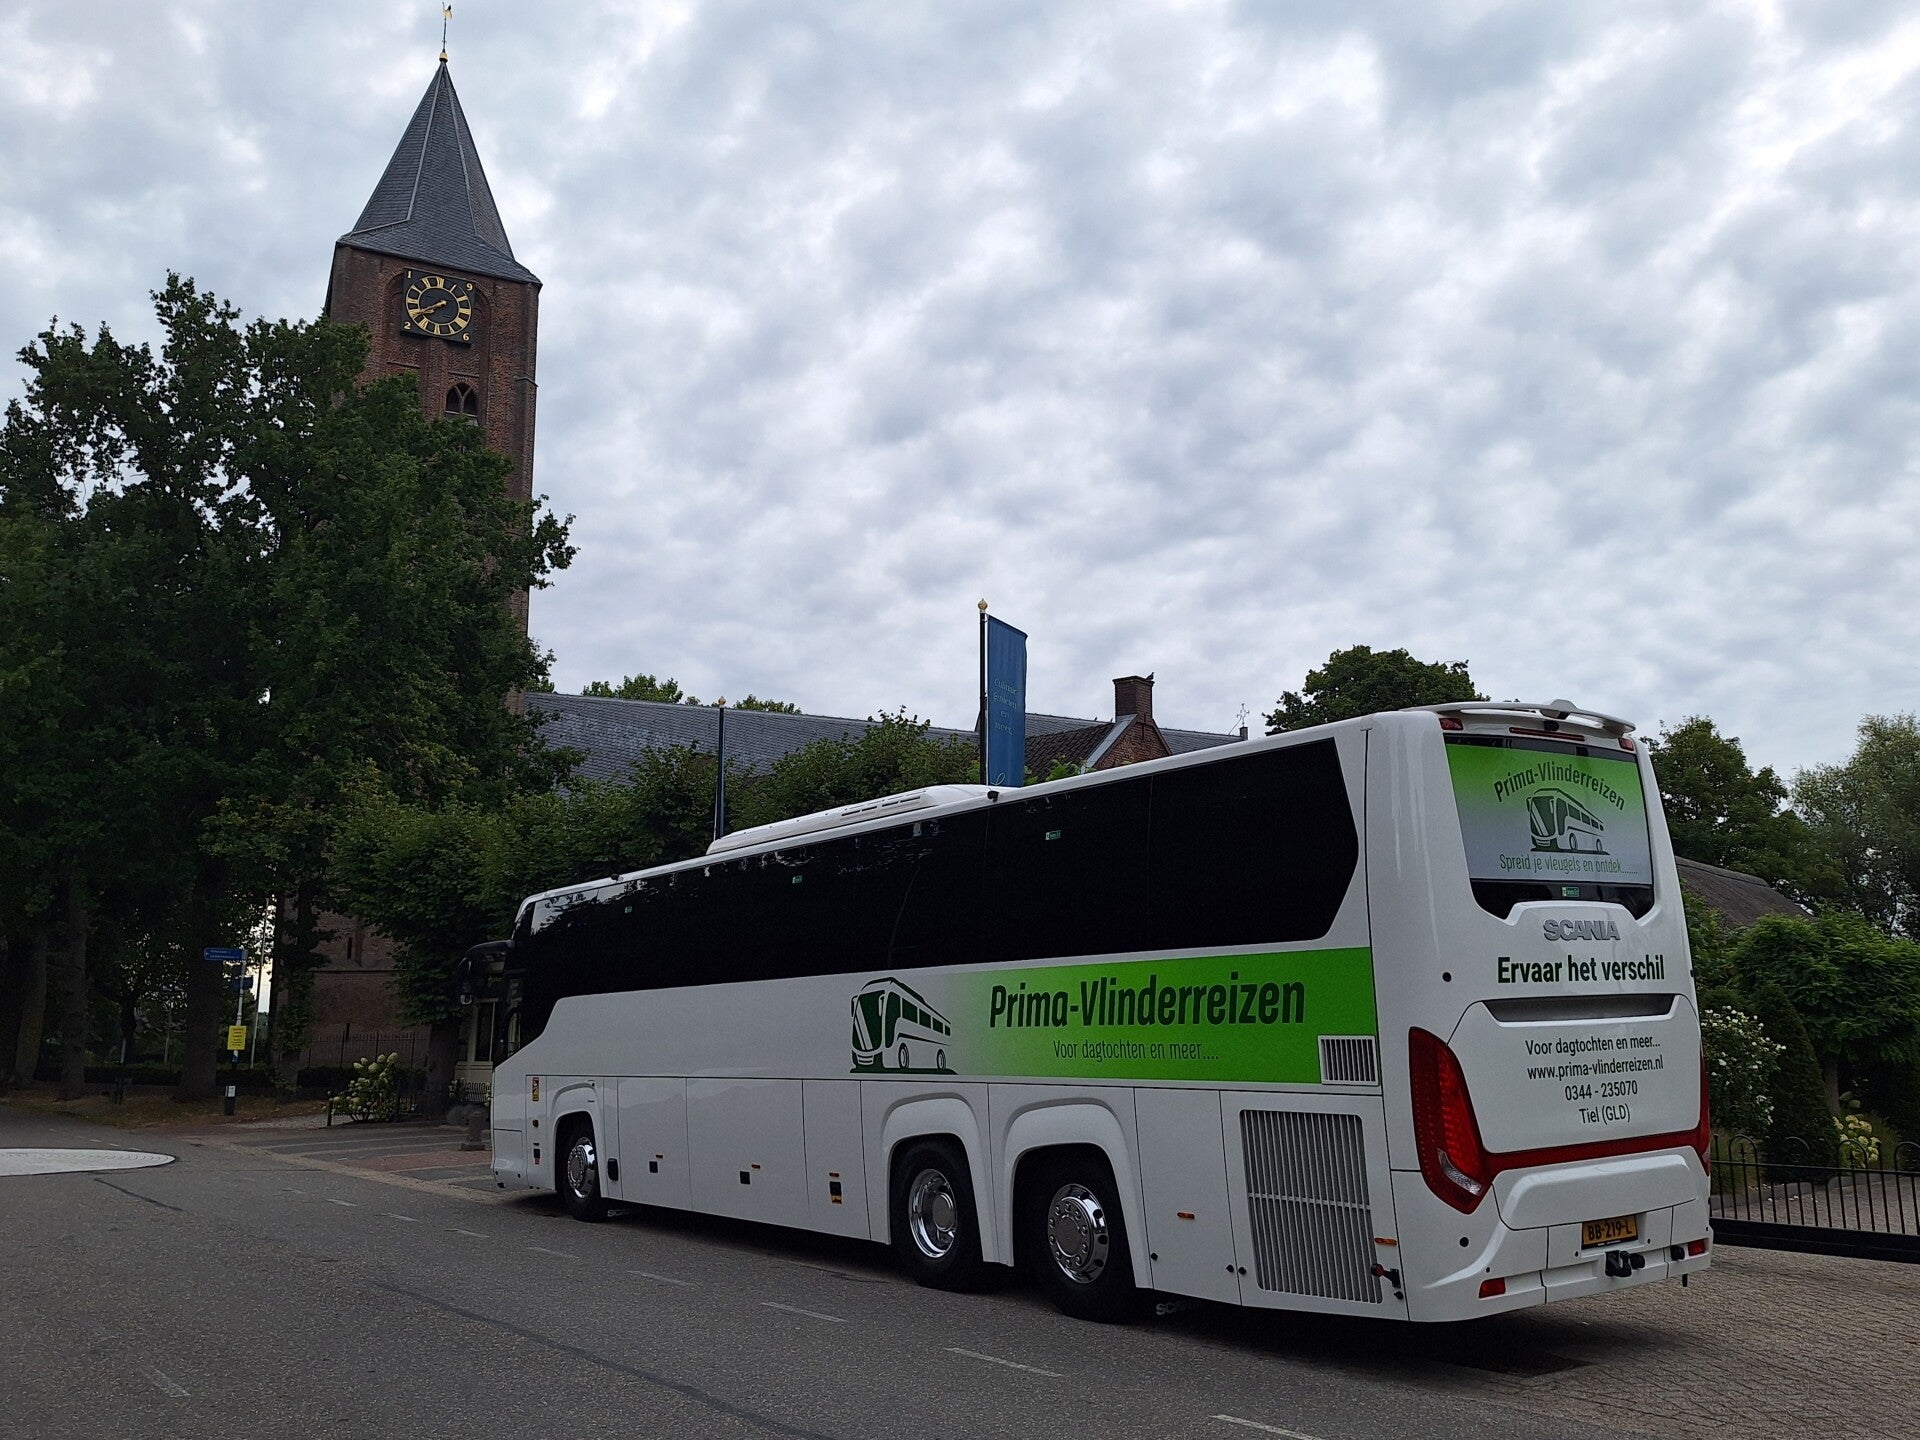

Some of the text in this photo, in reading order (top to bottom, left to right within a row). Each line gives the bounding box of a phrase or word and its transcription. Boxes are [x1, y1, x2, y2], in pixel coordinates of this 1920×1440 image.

[466, 283, 473, 291] 9
[403, 321, 411, 330] 2
[462, 333, 469, 341] 6
[1494, 761, 1625, 811] Prima-Vlinderreizen
[1500, 854, 1531, 872] Spreid
[1533, 857, 1543, 873] je
[1545, 856, 1581, 875] vleugels
[1583, 860, 1594, 872] en
[1543, 919, 1621, 941] SCANIA
[1497, 954, 1665, 983] Ervaar het verschil
[989, 971, 1305, 1028] Prima-Vlinderreizen
[1053, 1039, 1219, 1062] Voor dagtochten en meer....
[1525, 1036, 1660, 1056] Voor dagtochten en meer...
[1527, 1054, 1664, 1081] www.prima-vlinderreizen.nl
[1565, 1084, 1592, 1101] 0344
[1601, 1080, 1638, 1098] 235070
[1579, 1103, 1631, 1125] Tiel (GLD)
[1588, 1219, 1632, 1240] BB-219-L
